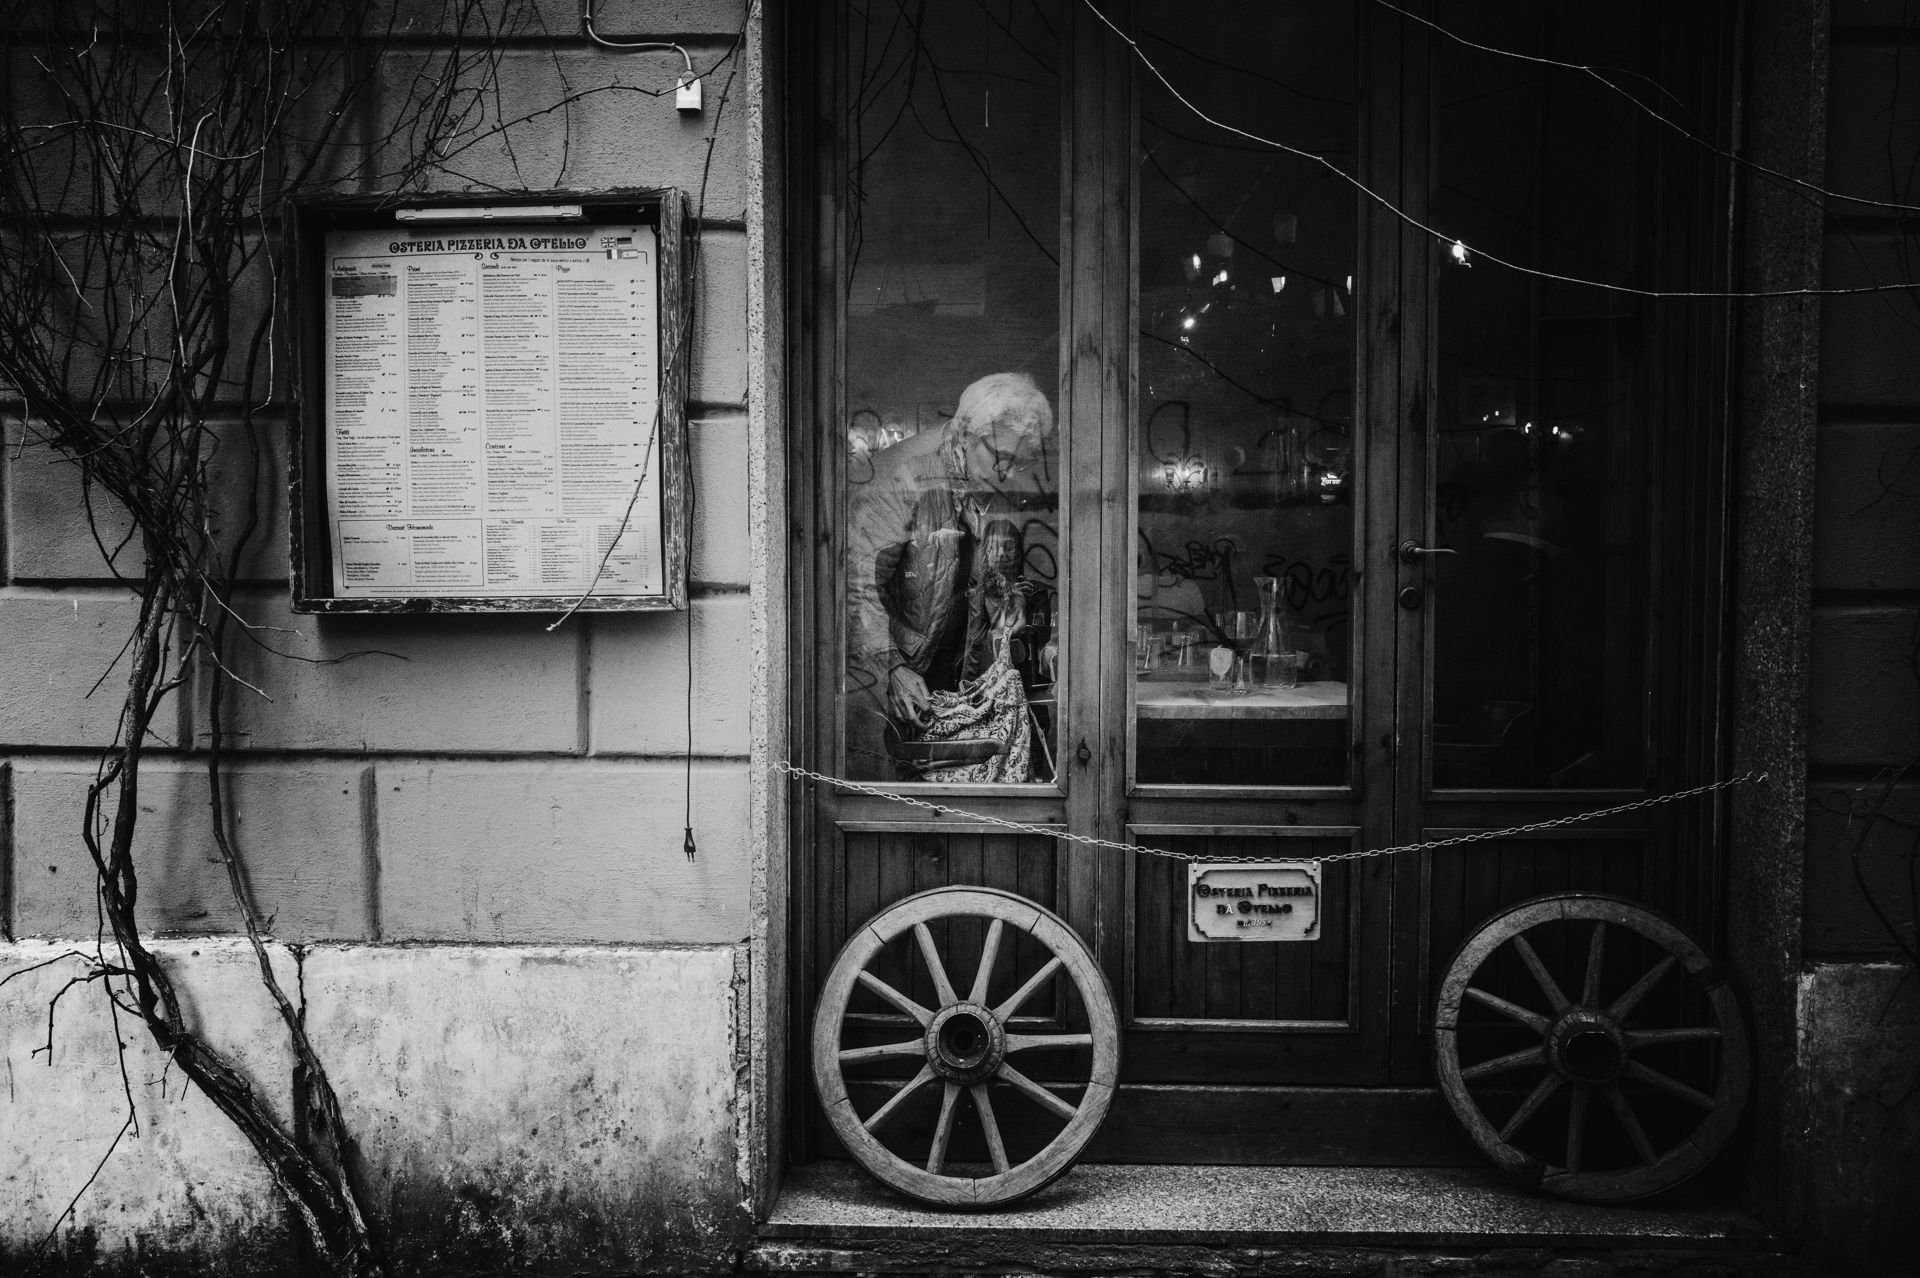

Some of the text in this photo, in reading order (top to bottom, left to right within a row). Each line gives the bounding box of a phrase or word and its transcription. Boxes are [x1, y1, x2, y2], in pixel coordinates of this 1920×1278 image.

[389, 237, 587, 253] OSTERIA PIZZERIA DA OTELLO
